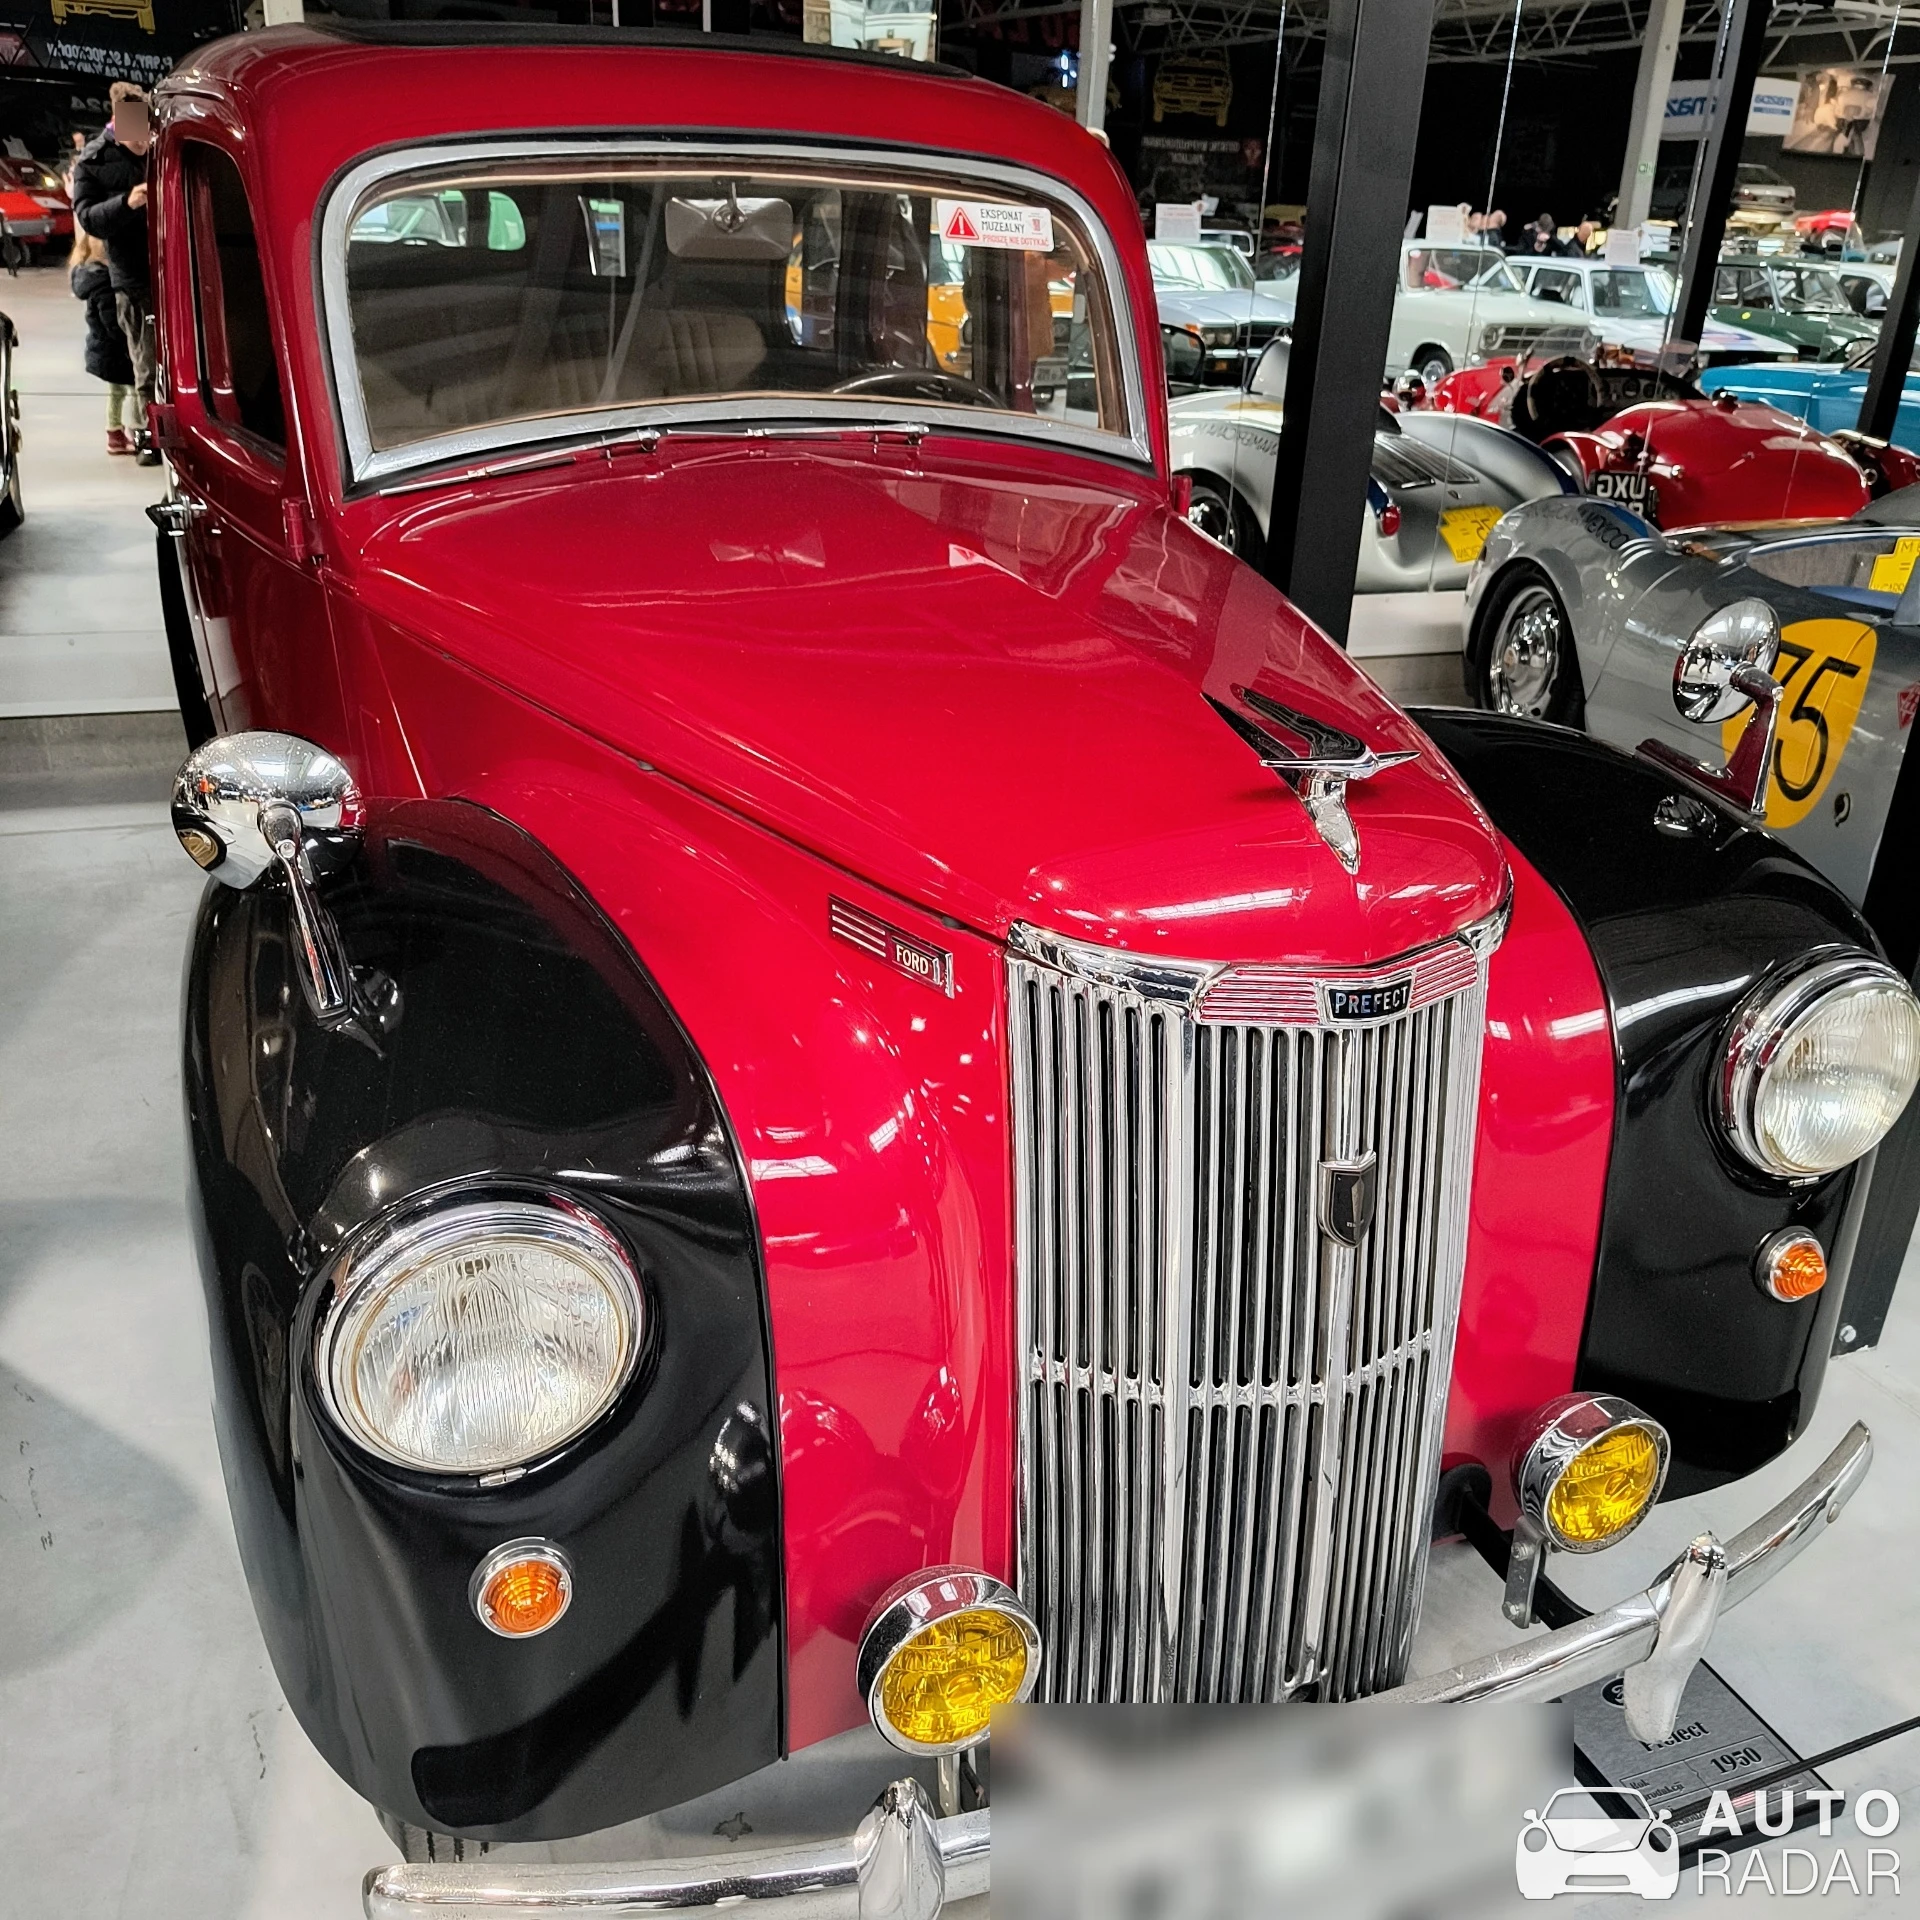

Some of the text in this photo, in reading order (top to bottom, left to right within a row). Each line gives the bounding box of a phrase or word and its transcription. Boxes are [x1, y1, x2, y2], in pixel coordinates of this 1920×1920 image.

[980, 208, 1023, 222] EKSPONAT
[981, 221, 1025, 235] MUZEALNY
[895, 944, 929, 975] FORD
[1335, 985, 1409, 1014] PREFECT
[1709, 1746, 1762, 1774] 1950
